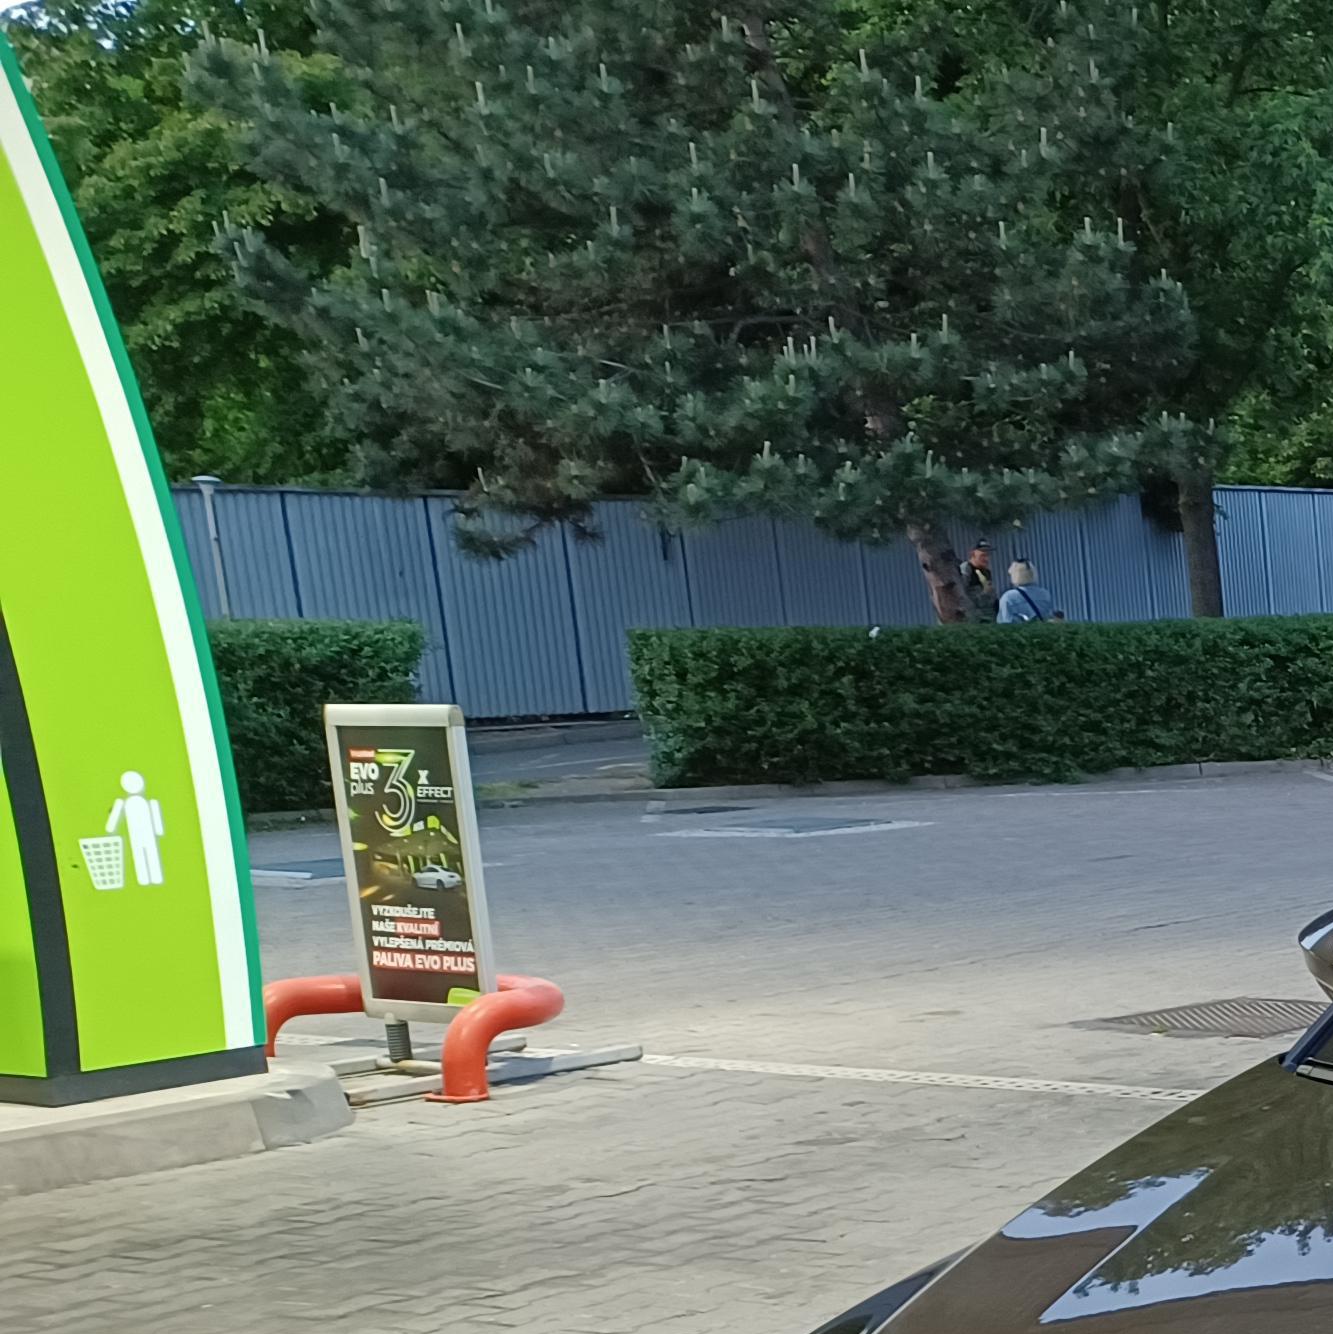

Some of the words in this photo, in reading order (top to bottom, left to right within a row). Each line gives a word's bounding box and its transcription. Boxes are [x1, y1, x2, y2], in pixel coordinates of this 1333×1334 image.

[350, 763, 379, 781] EVO
[351, 780, 375, 797] plus
[417, 786, 453, 798] EFFECT
[372, 919, 395, 932] NAŠE
[373, 952, 412, 968] PALIVA
[416, 955, 441, 969] EVO
[443, 957, 475, 972] PLUS
